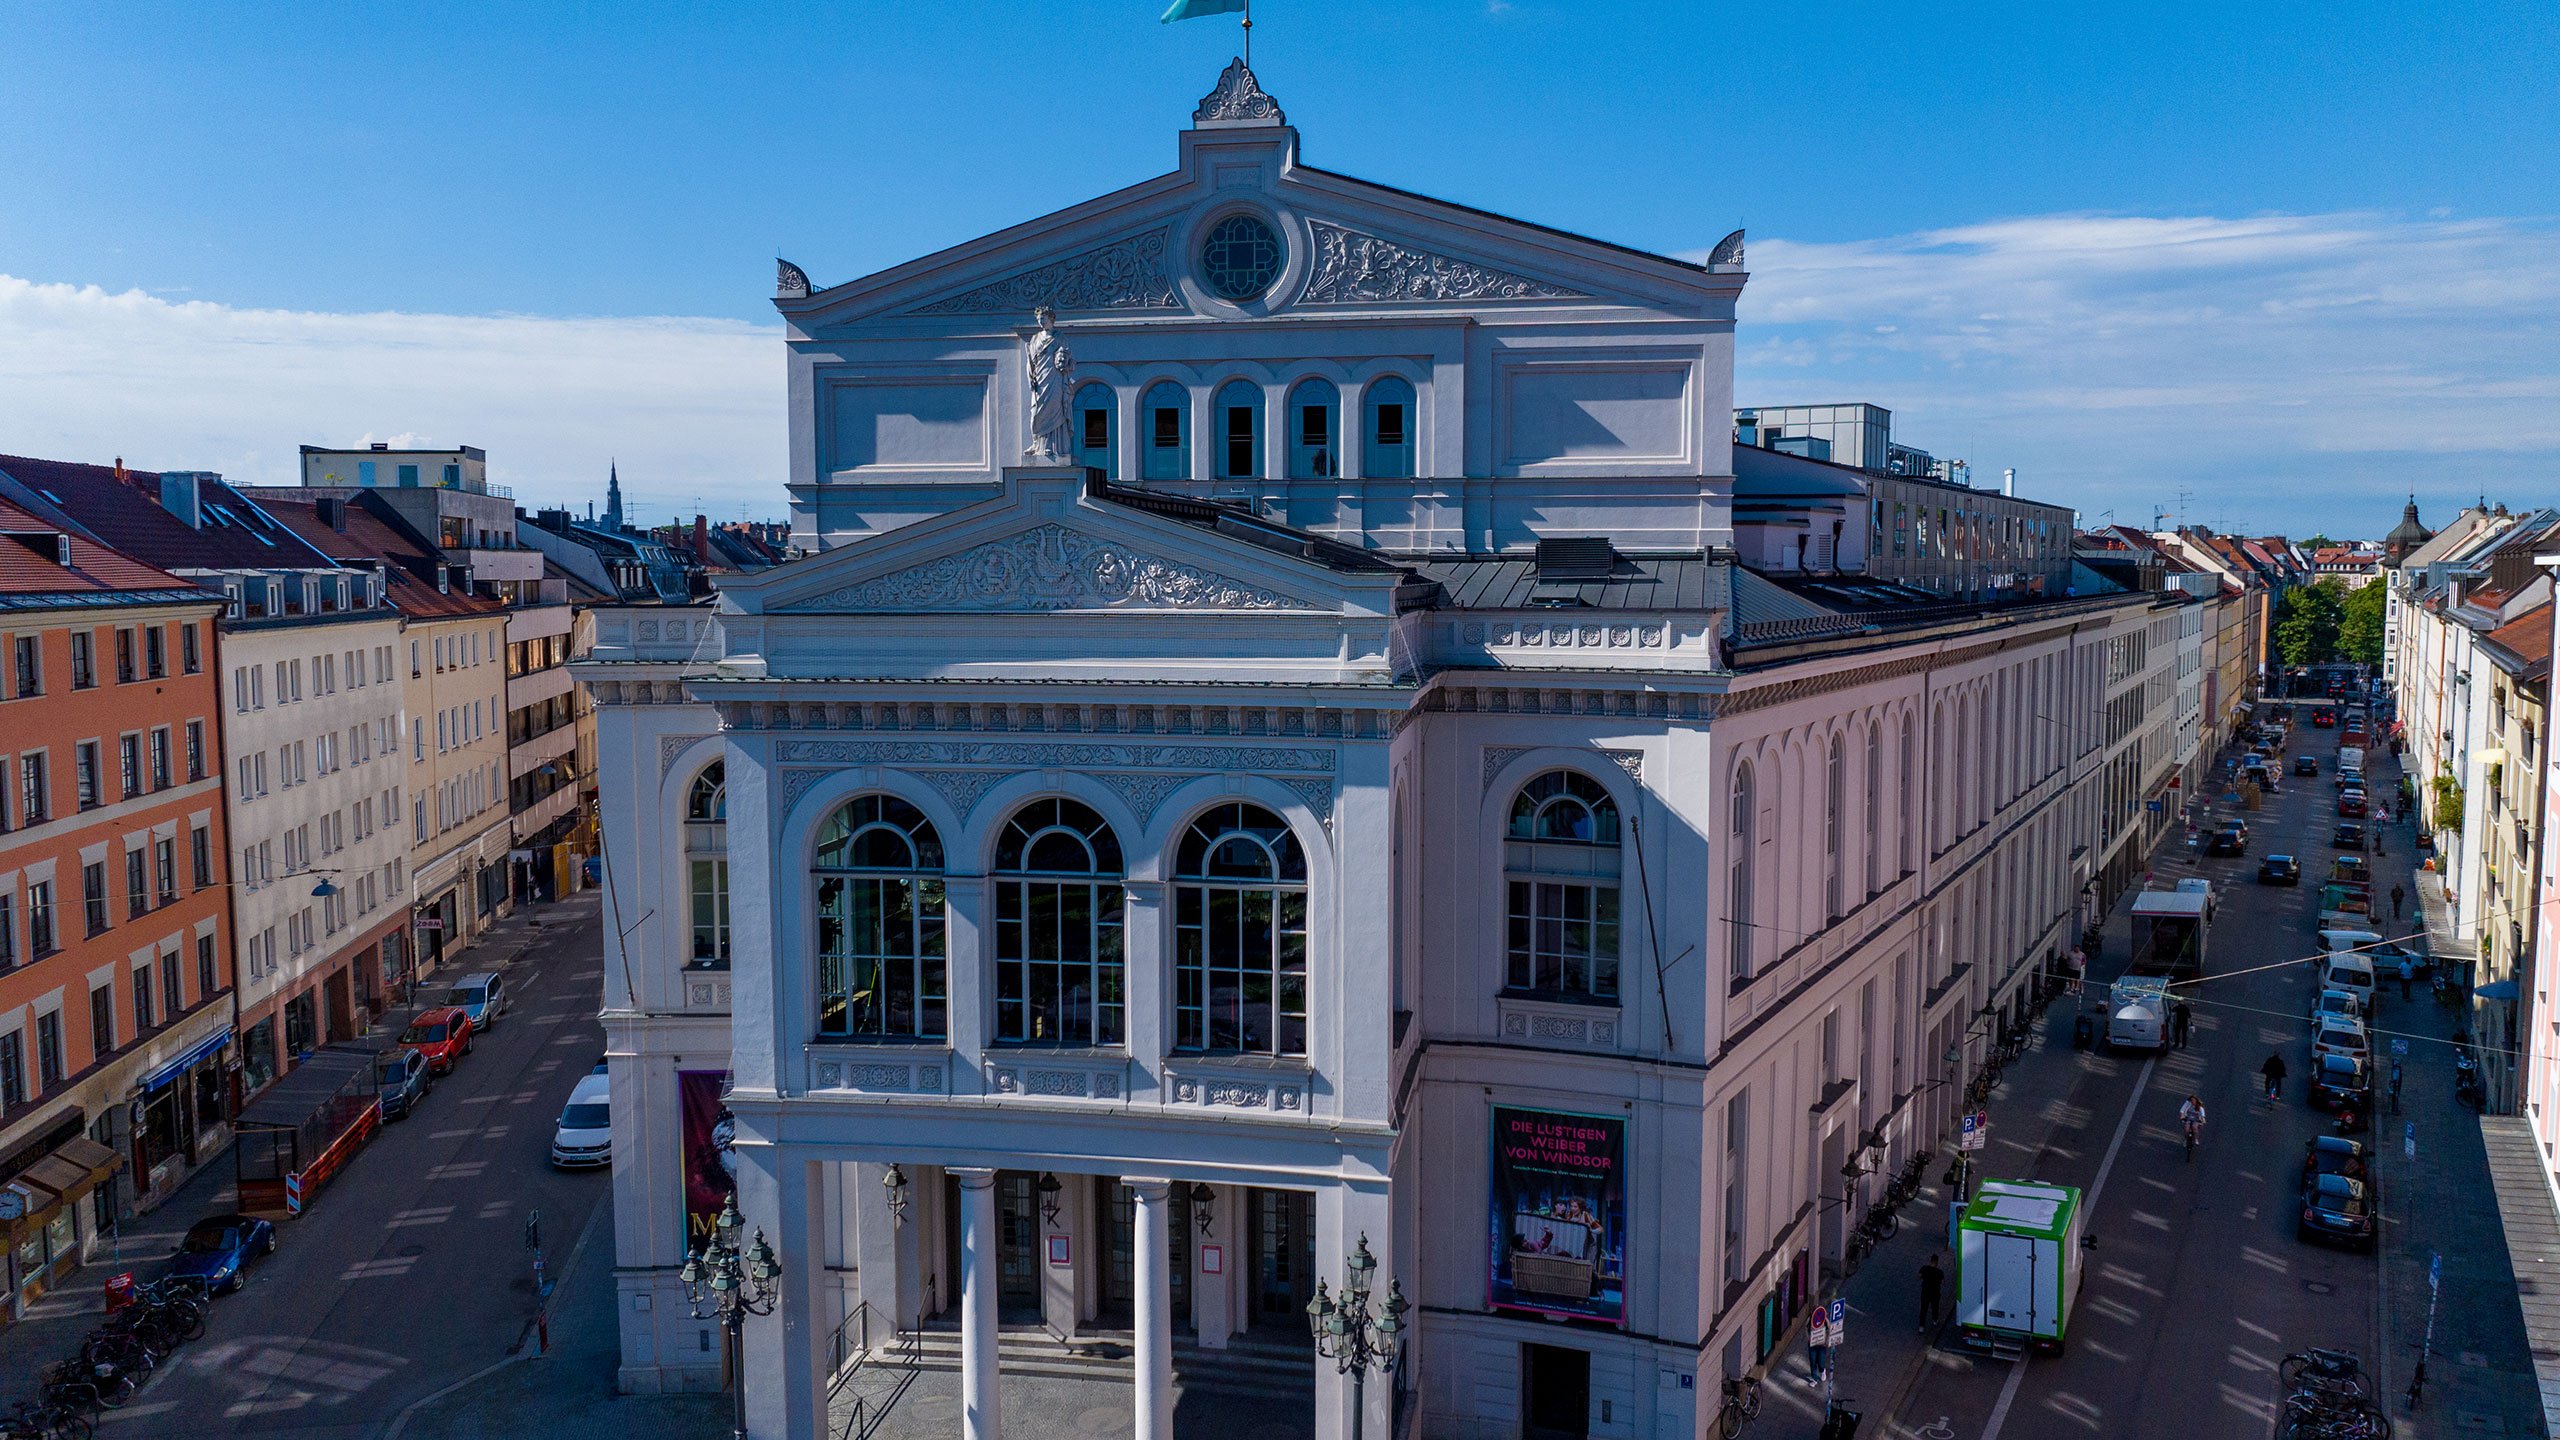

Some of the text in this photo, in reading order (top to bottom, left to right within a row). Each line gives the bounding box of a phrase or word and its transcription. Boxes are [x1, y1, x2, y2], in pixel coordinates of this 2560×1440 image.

[1511, 1121, 1606, 1141] DIE LUSTIGEN
[1964, 1118, 1973, 1131] P
[1530, 1135, 1586, 1153] WEIBER
[1505, 1145, 1612, 1169] VON WINDSOR
[1833, 1303, 1841, 1320] P
